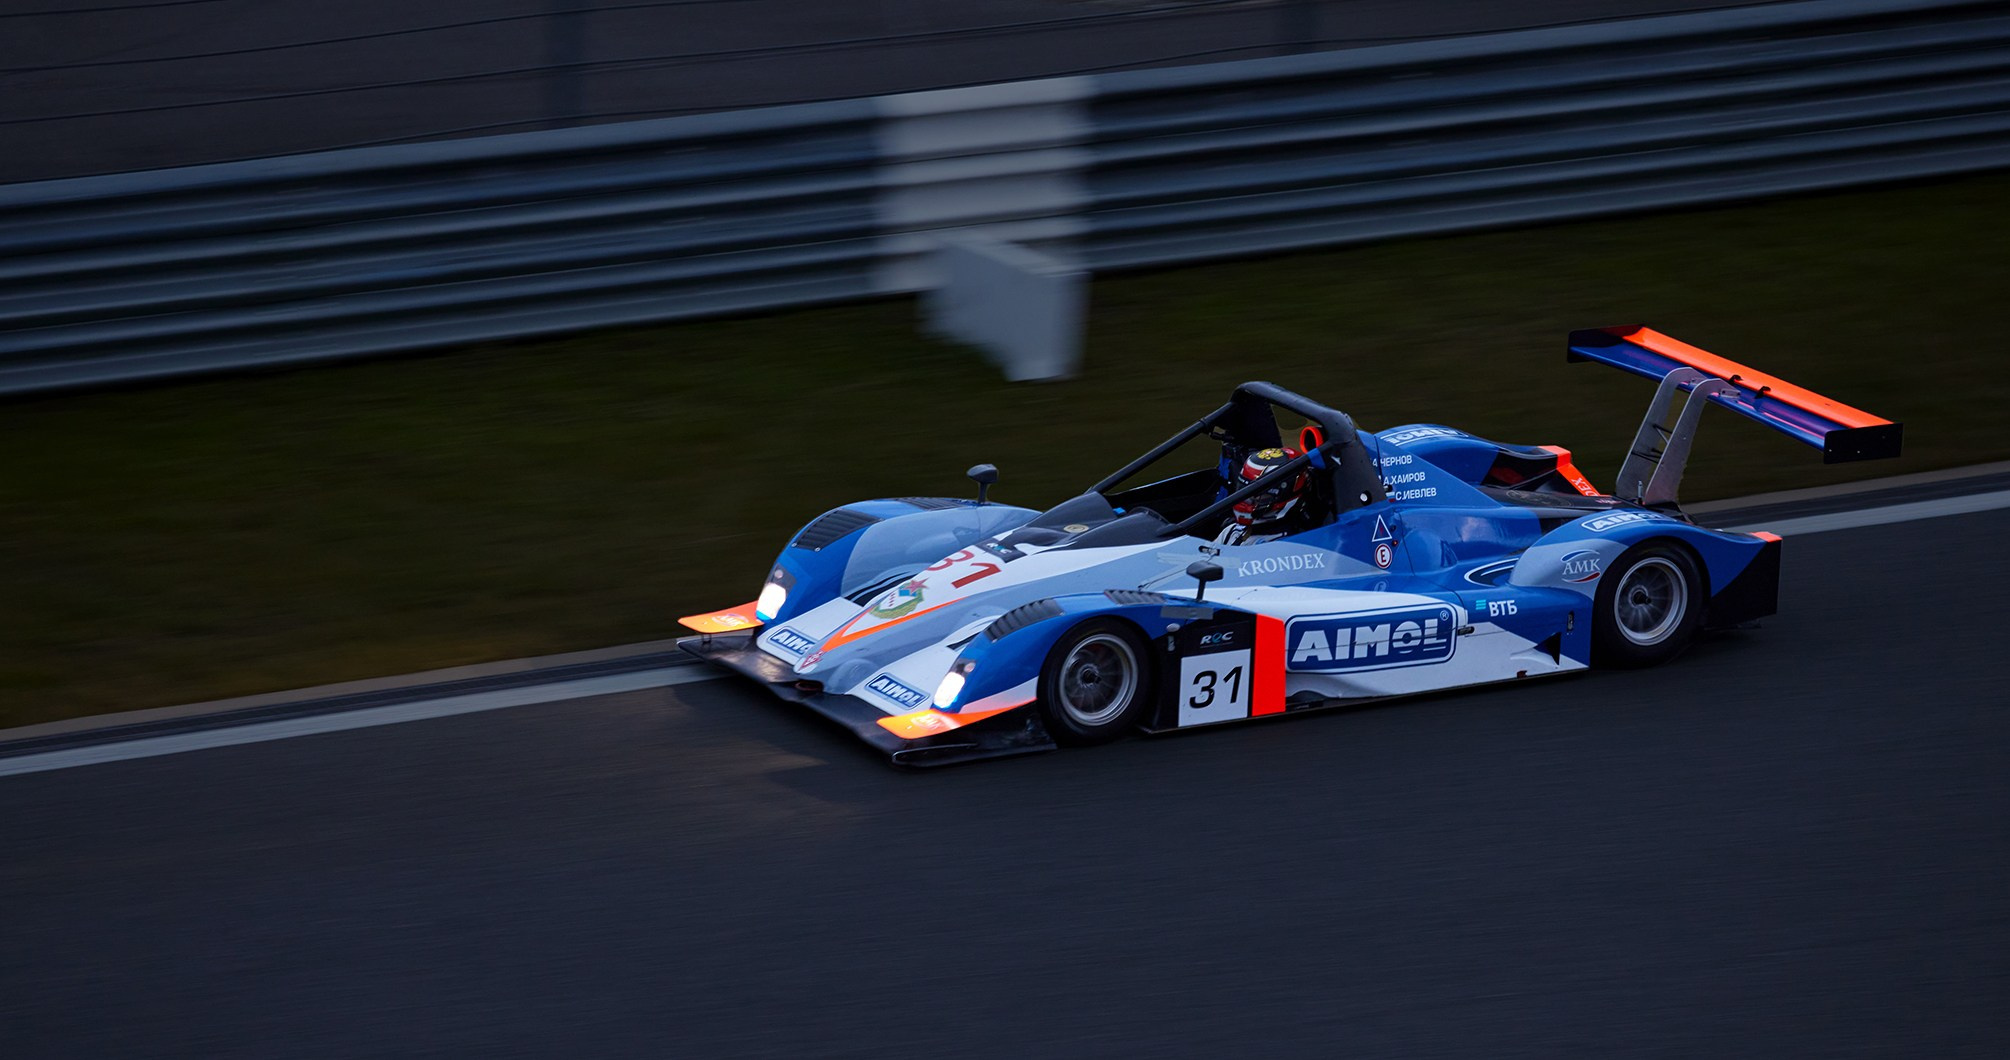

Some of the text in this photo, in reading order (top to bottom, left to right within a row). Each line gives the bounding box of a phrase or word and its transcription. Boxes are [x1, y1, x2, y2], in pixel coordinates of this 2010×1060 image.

[926, 549, 1002, 589] 31
[1238, 553, 1325, 578] KRONDEX
[1563, 558, 1600, 576] AMK
[1489, 600, 1518, 617] ВТБ
[1291, 618, 1447, 663] AIMOL
[871, 677, 923, 705] AIMOL
[1189, 665, 1243, 709] 31
